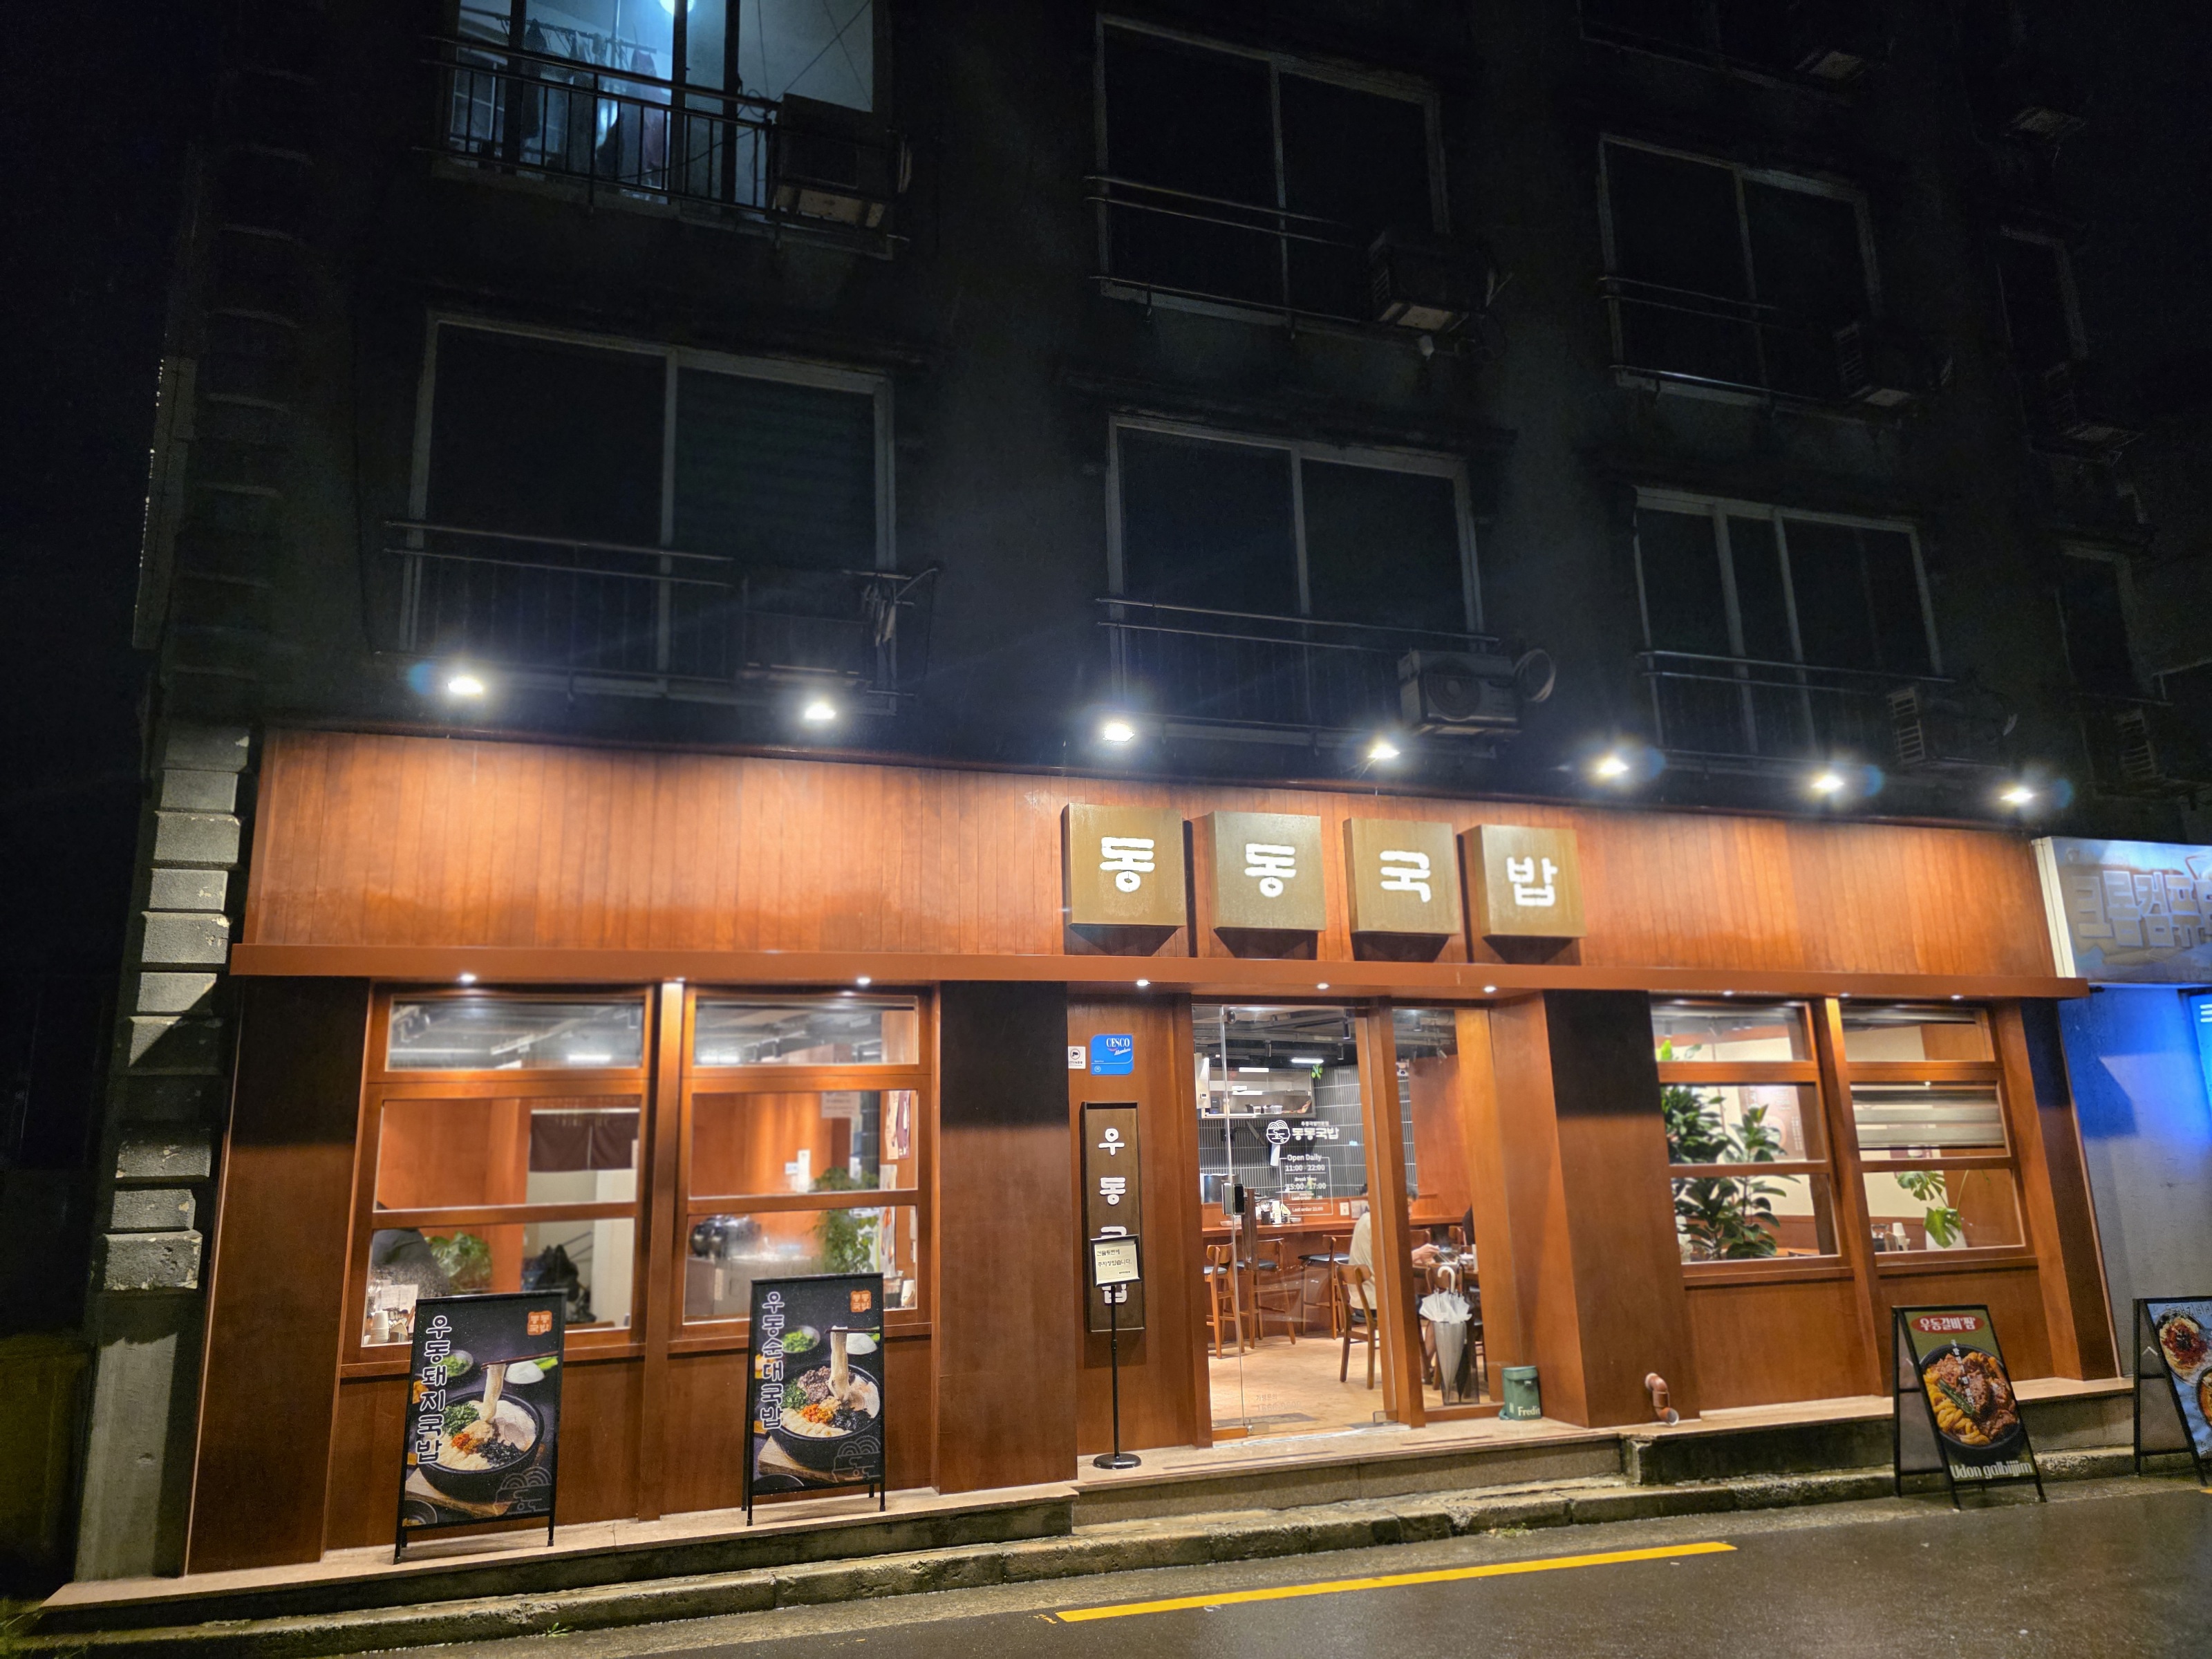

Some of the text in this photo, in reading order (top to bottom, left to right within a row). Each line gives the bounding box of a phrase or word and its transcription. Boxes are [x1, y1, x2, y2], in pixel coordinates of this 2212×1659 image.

[1100, 836, 1557, 907] 동동국밥
[1106, 1038, 1130, 1047] CESCO
[1292, 1127, 1340, 1141] 동동국밥
[1306, 1154, 1322, 1162] Daily
[530, 1315, 550, 1324] 동동
[760, 1291, 785, 1430] 우동순대국밥
[416, 1315, 452, 1465] 우동돼지국밥
[1949, 1460, 2034, 1479] Udon galbijjim
